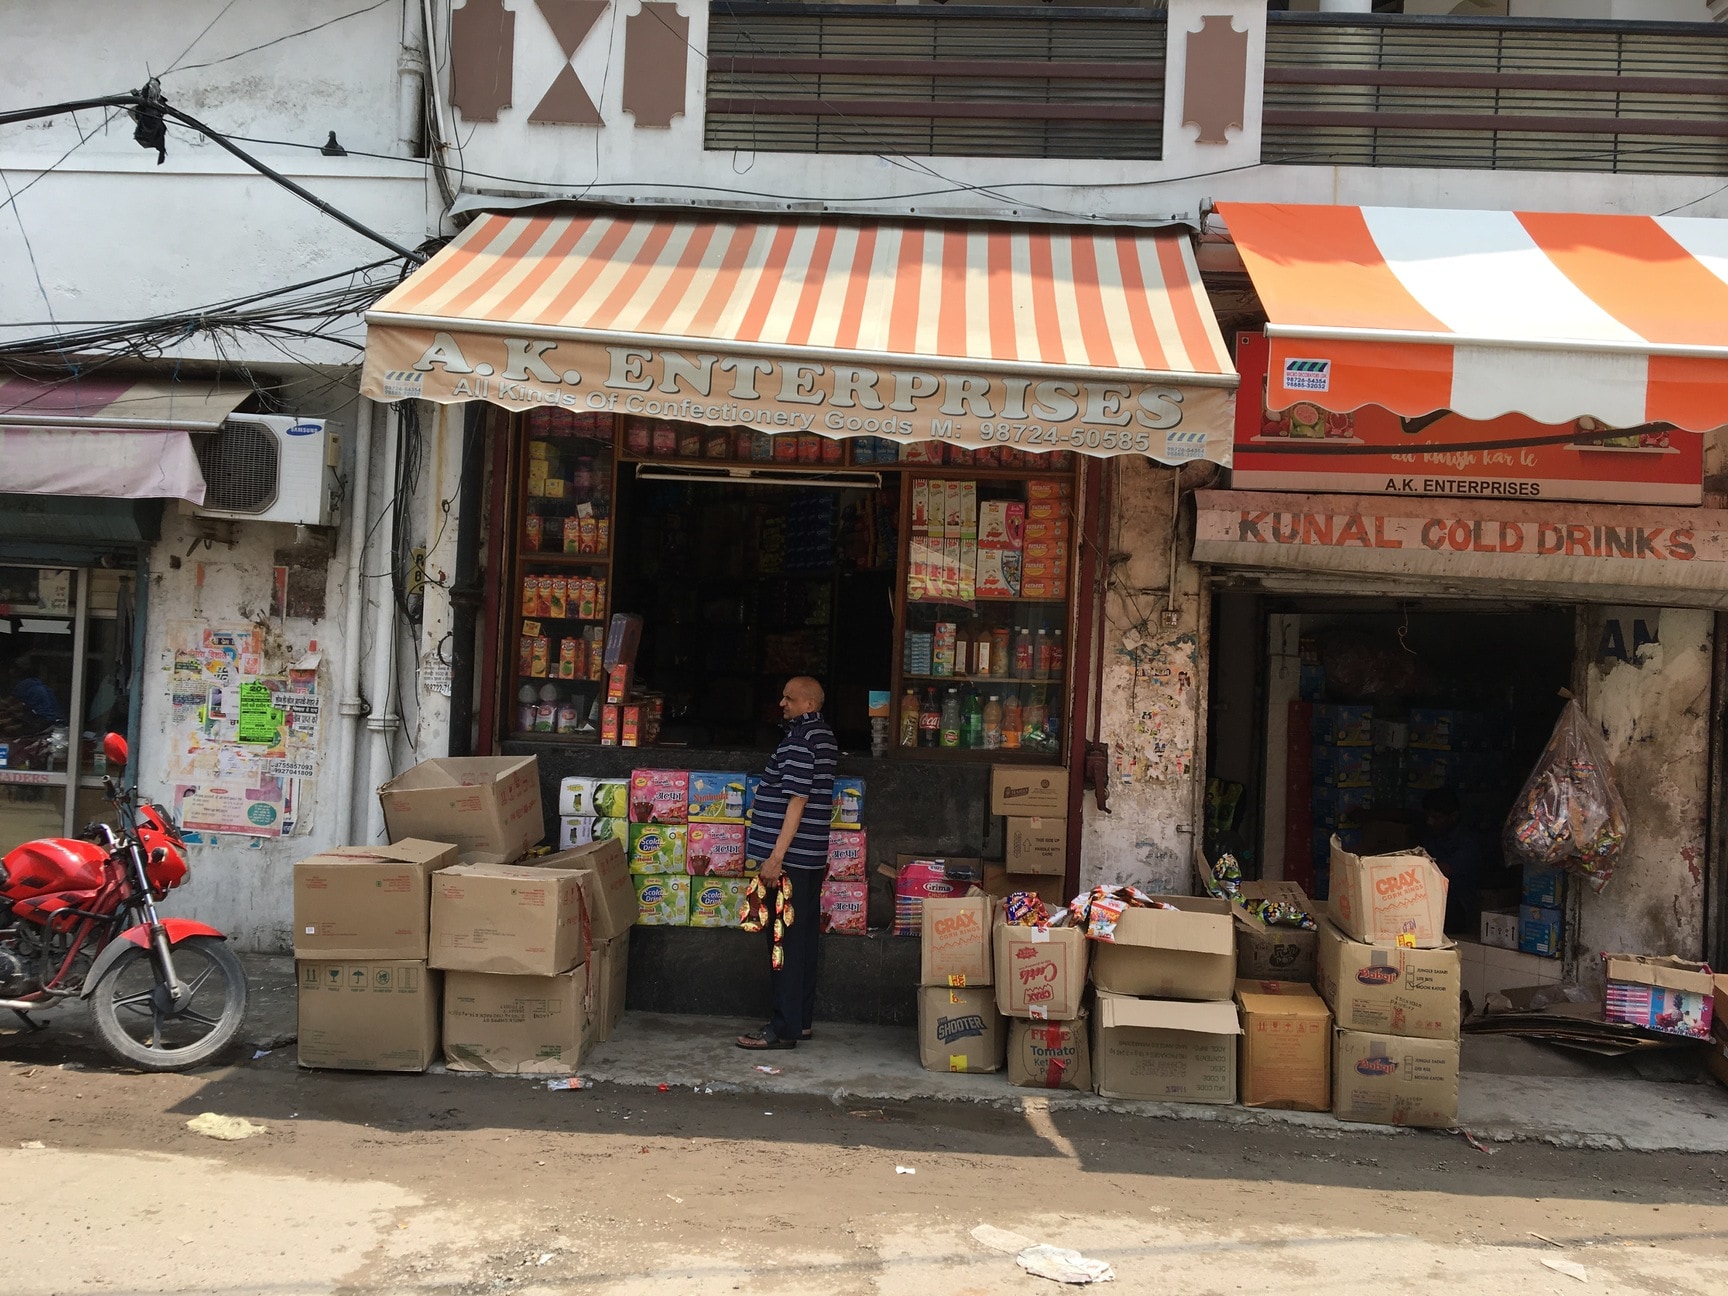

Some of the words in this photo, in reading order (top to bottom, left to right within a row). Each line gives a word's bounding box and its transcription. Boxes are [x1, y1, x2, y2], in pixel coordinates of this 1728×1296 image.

[603, 345, 1185, 430] ENTERPRISES
[453, 377, 489, 398] All
[499, 380, 576, 406] Kinds
[587, 388, 619, 410] Of
[624, 395, 815, 430] Confectionery
[824, 410, 913, 435] Goods
[930, 418, 962, 440] M:
[979, 422, 1151, 451] 98724-50585
[1385, 477, 1418, 492] A.K.
[1422, 479, 1540, 496] ENTERPRISES
[1238, 510, 1403, 549] KUNAL
[1421, 518, 1523, 554] COLD
[1536, 523, 1698, 561] DRINKS
[0, 771, 49, 784] ADERS
[1376, 868, 1421, 895] CRAX
[934, 911, 978, 935] CRAX
[1018, 962, 1058, 985] Curls
[1027, 989, 1051, 1003] CRAX
[938, 1016, 985, 1039] SHOOTER
[1031, 1028, 1071, 1041] FRE
[1030, 1045, 1076, 1056] Tomato
[1034, 1057, 1072, 1068] Ketup
